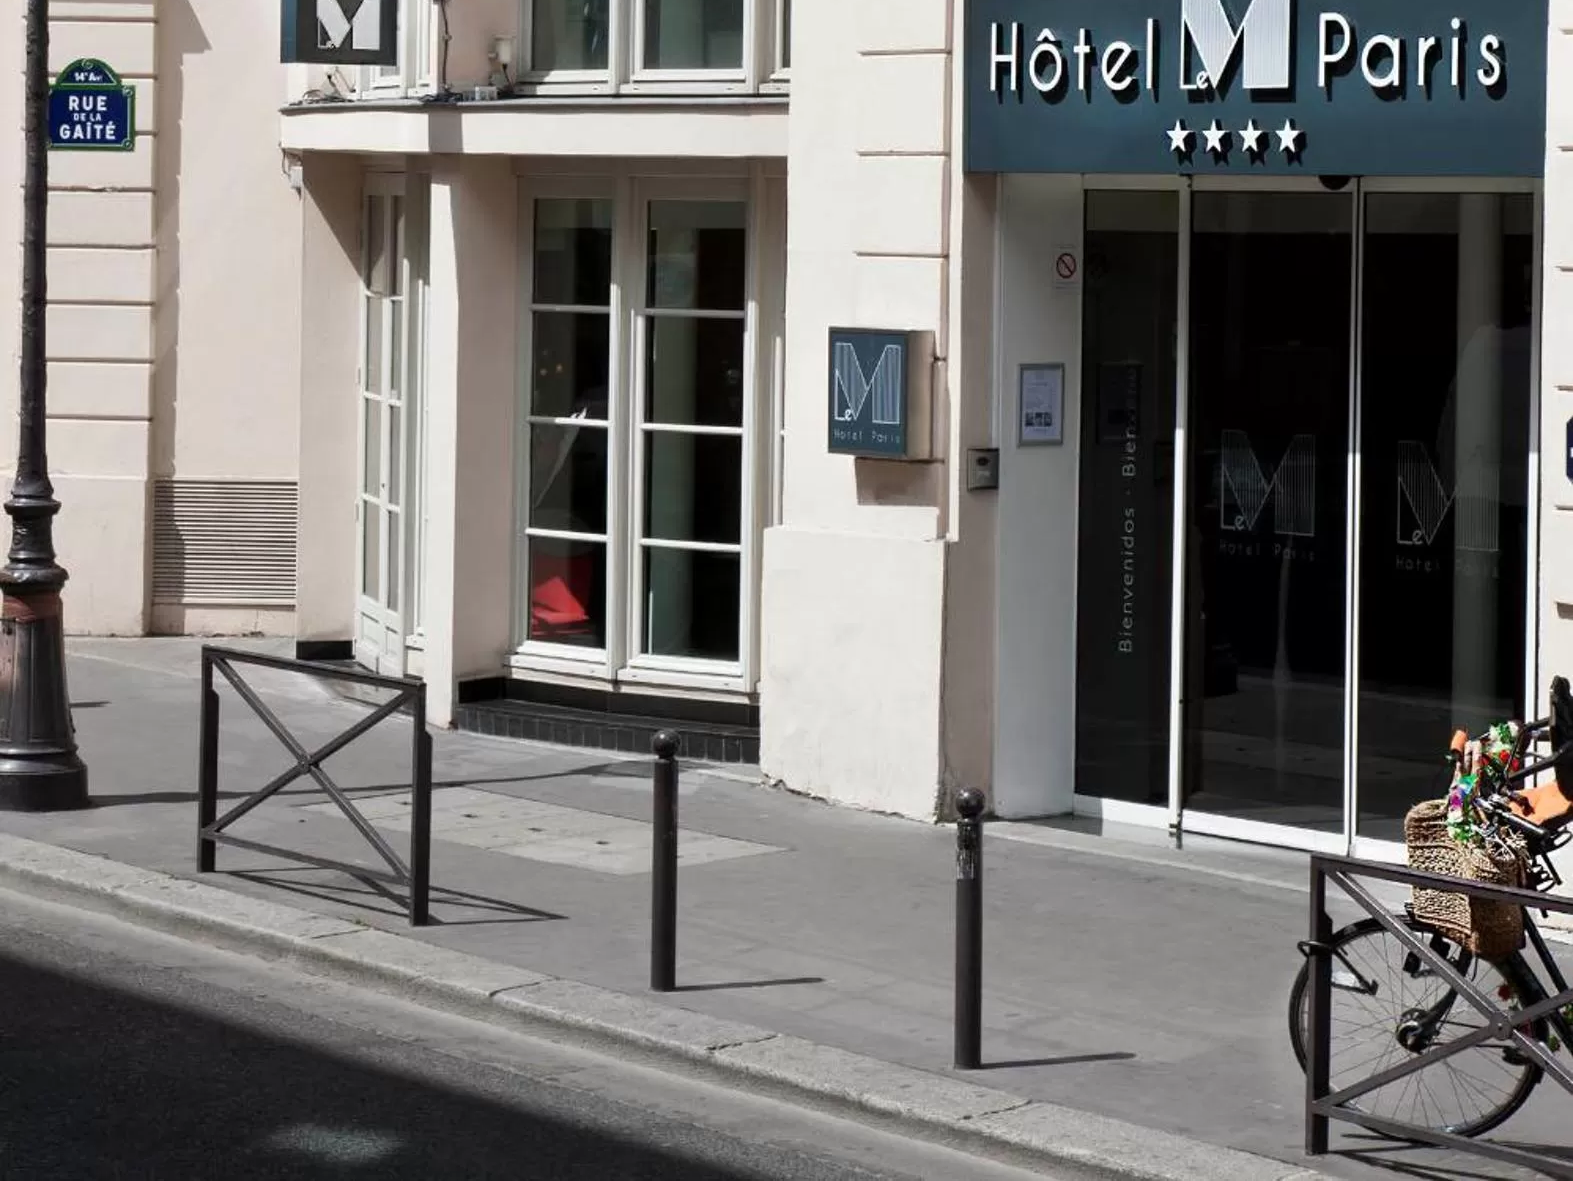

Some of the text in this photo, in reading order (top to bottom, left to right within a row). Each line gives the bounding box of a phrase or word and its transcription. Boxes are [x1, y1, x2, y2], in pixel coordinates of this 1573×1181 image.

[989, 17, 1155, 92] Hôtel
[1317, 11, 1503, 88] Paris
[69, 95, 107, 111] RUE
[73, 112, 102, 121] DE LA
[59, 120, 116, 139] GAÎTÉ
[1117, 506, 1136, 653] Bienvenidos
